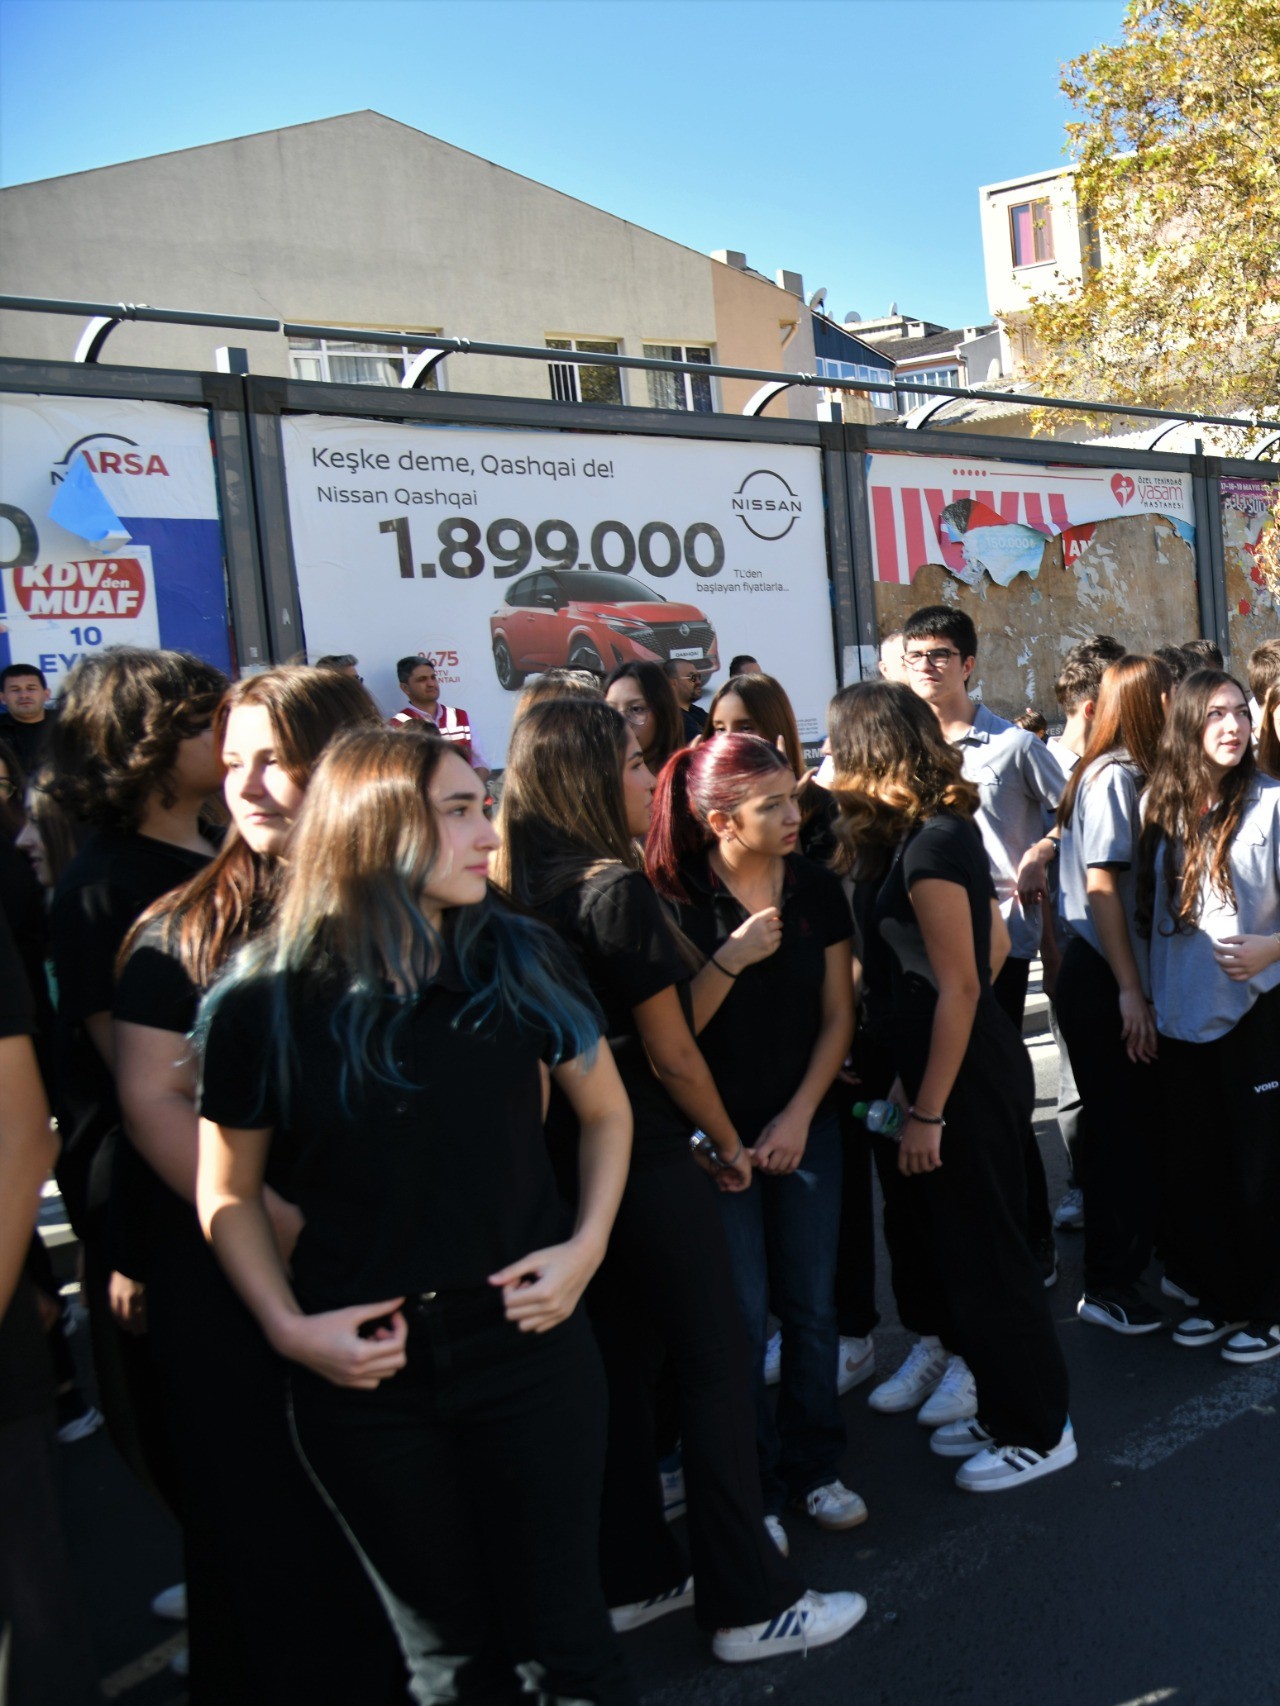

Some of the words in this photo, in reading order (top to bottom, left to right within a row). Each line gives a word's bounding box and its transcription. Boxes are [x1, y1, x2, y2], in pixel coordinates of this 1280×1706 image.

[312, 447, 390, 474] Keşke
[398, 450, 475, 477] deme,
[480, 454, 576, 481] Qashqai
[583, 459, 614, 478] de!
[317, 486, 388, 503] Nissan
[394, 488, 478, 509] Qashqai
[732, 498, 802, 512] NISSAN
[378, 516, 725, 579] 1.899.000
[733, 568, 763, 578] TL'den
[696, 582, 741, 594] başlayan
[30, 590, 139, 615] MUAF
[70, 626, 102, 646] 10
[1254, 1081, 1279, 1093] VOID
